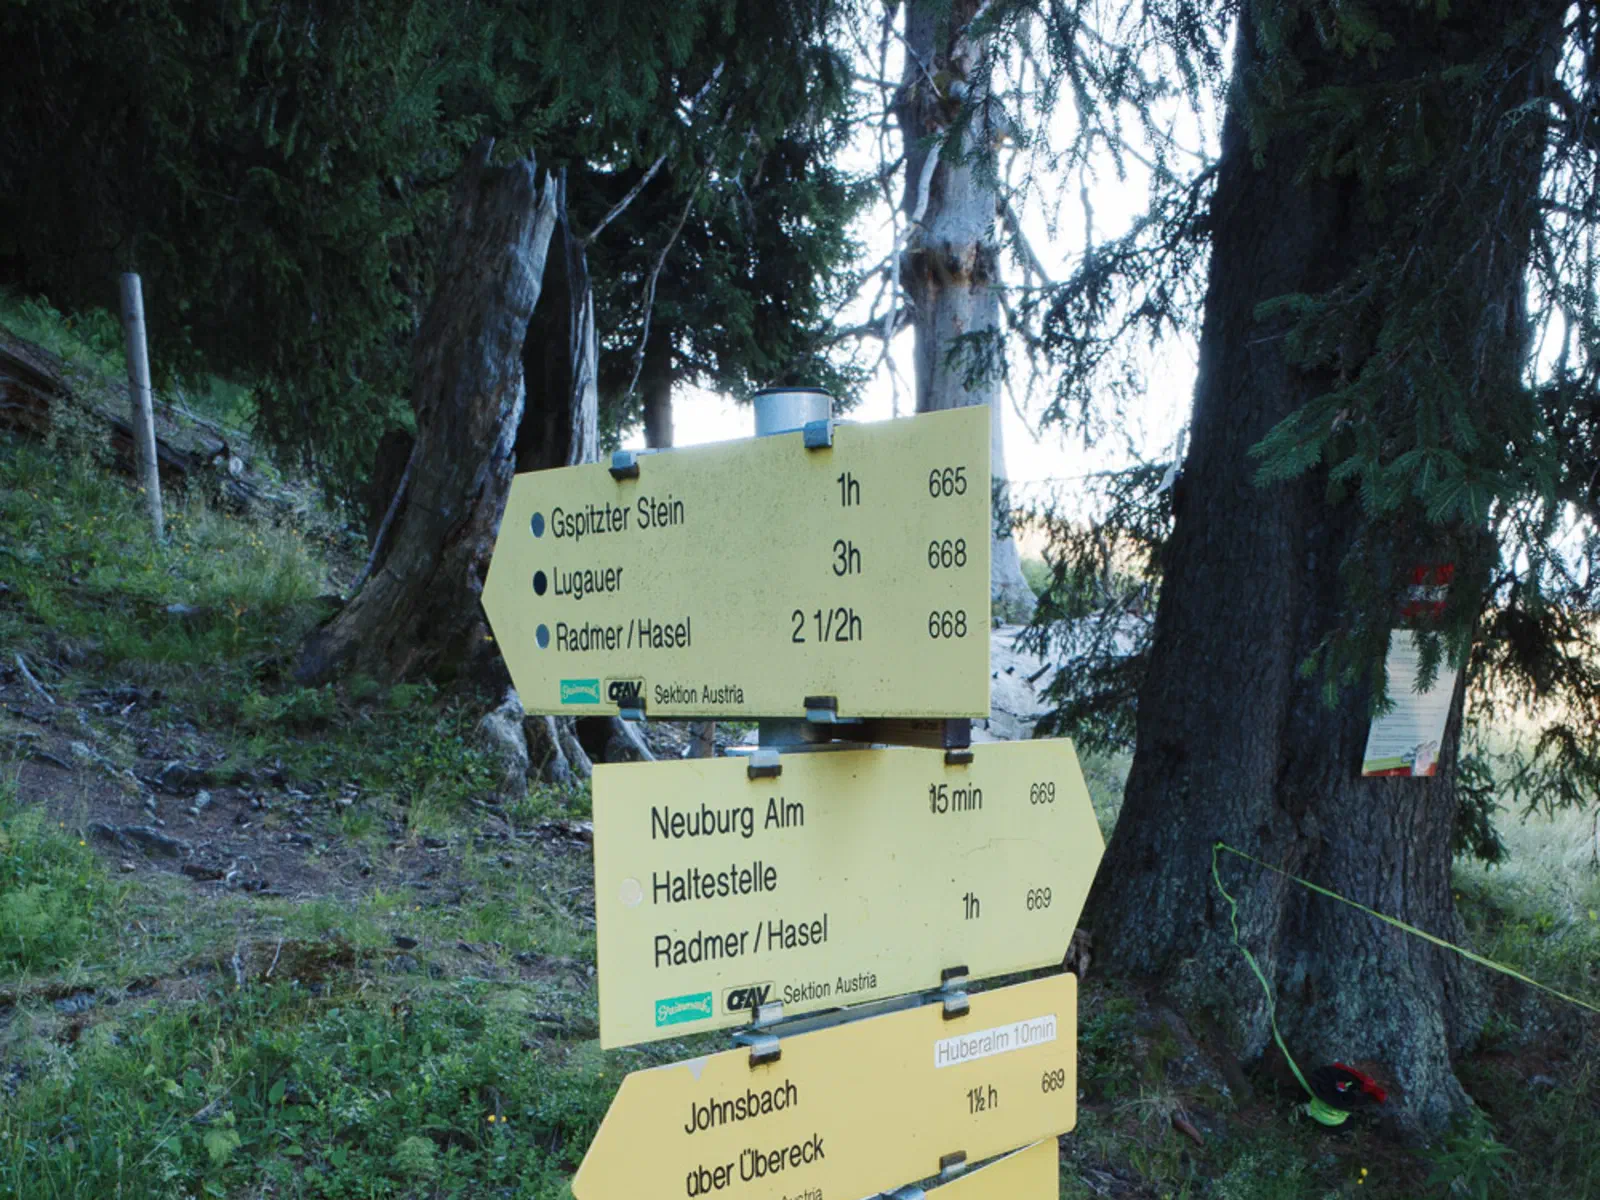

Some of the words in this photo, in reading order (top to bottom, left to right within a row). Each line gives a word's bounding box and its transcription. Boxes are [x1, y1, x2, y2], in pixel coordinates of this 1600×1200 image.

[551, 501, 631, 542] Gspitzter
[637, 494, 684, 530] Stein
[837, 471, 861, 507] 1h
[928, 466, 968, 498] 665
[553, 566, 623, 600] Lugauer
[832, 539, 862, 576] 3h
[928, 538, 967, 569] 668
[556, 621, 624, 652] Radmer
[638, 616, 691, 649] Hasel
[791, 609, 806, 643] 2
[928, 609, 968, 639] 668
[654, 684, 697, 704] Sektion
[701, 684, 745, 704] Austria
[651, 802, 754, 840] Neuburg
[764, 796, 805, 829] Alm
[1029, 781, 1056, 805] 669
[652, 860, 777, 905] Haltestelle
[962, 891, 981, 920] 1h
[1026, 886, 1052, 911] 669
[654, 930, 749, 968] Radmer
[767, 912, 828, 950] Hasel
[783, 984, 831, 1004] Sektion
[835, 972, 878, 994] Austria
[938, 1030, 1009, 1064] Huberalm
[1014, 1021, 1054, 1045] 10min
[684, 1078, 798, 1135] Johnsbach
[1041, 1068, 1065, 1094] 669
[686, 1164, 734, 1198] über
[740, 1132, 825, 1182] Übereck
